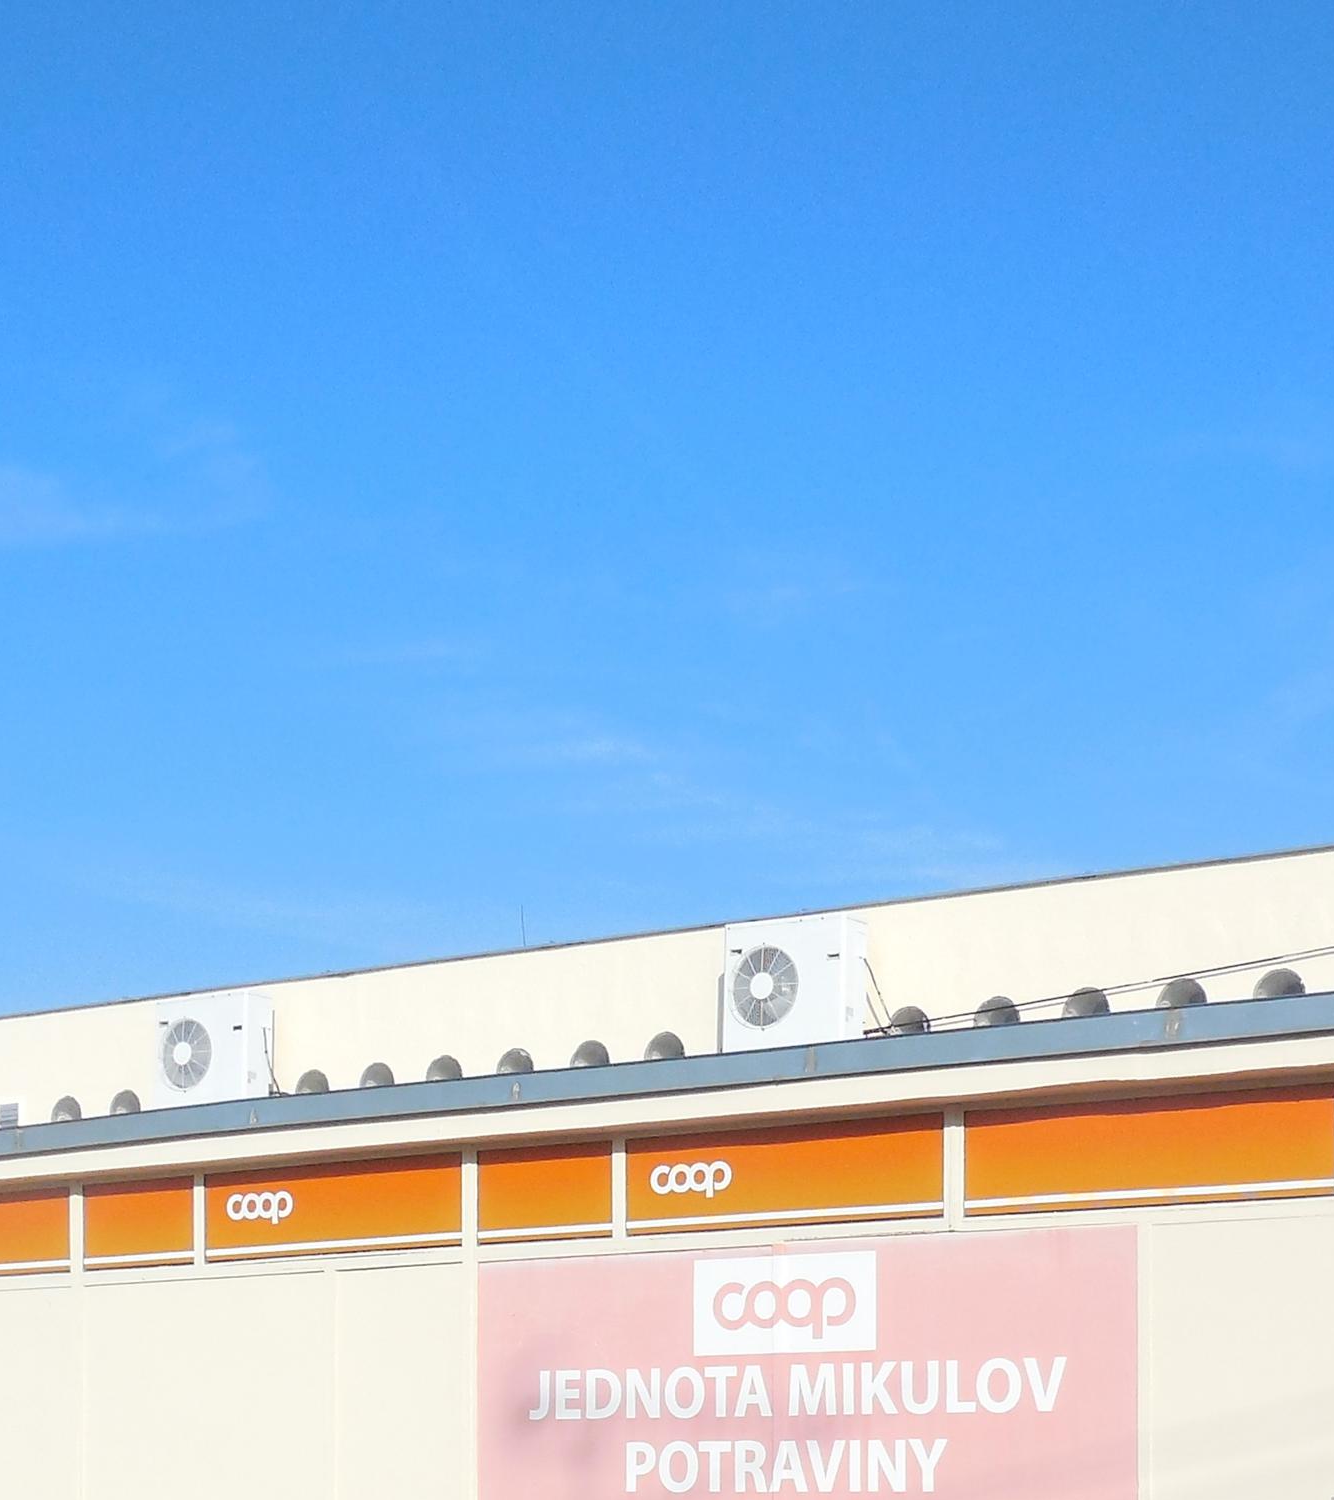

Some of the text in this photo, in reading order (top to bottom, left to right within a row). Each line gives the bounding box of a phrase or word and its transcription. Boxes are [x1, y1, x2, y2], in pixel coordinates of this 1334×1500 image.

[649, 1160, 733, 1198] coop
[226, 1190, 294, 1225] coop
[713, 1277, 857, 1339] coop
[528, 1356, 1068, 1420] JEDNOTA MIKULOV
[624, 1438, 948, 1493] POTRAVINY
